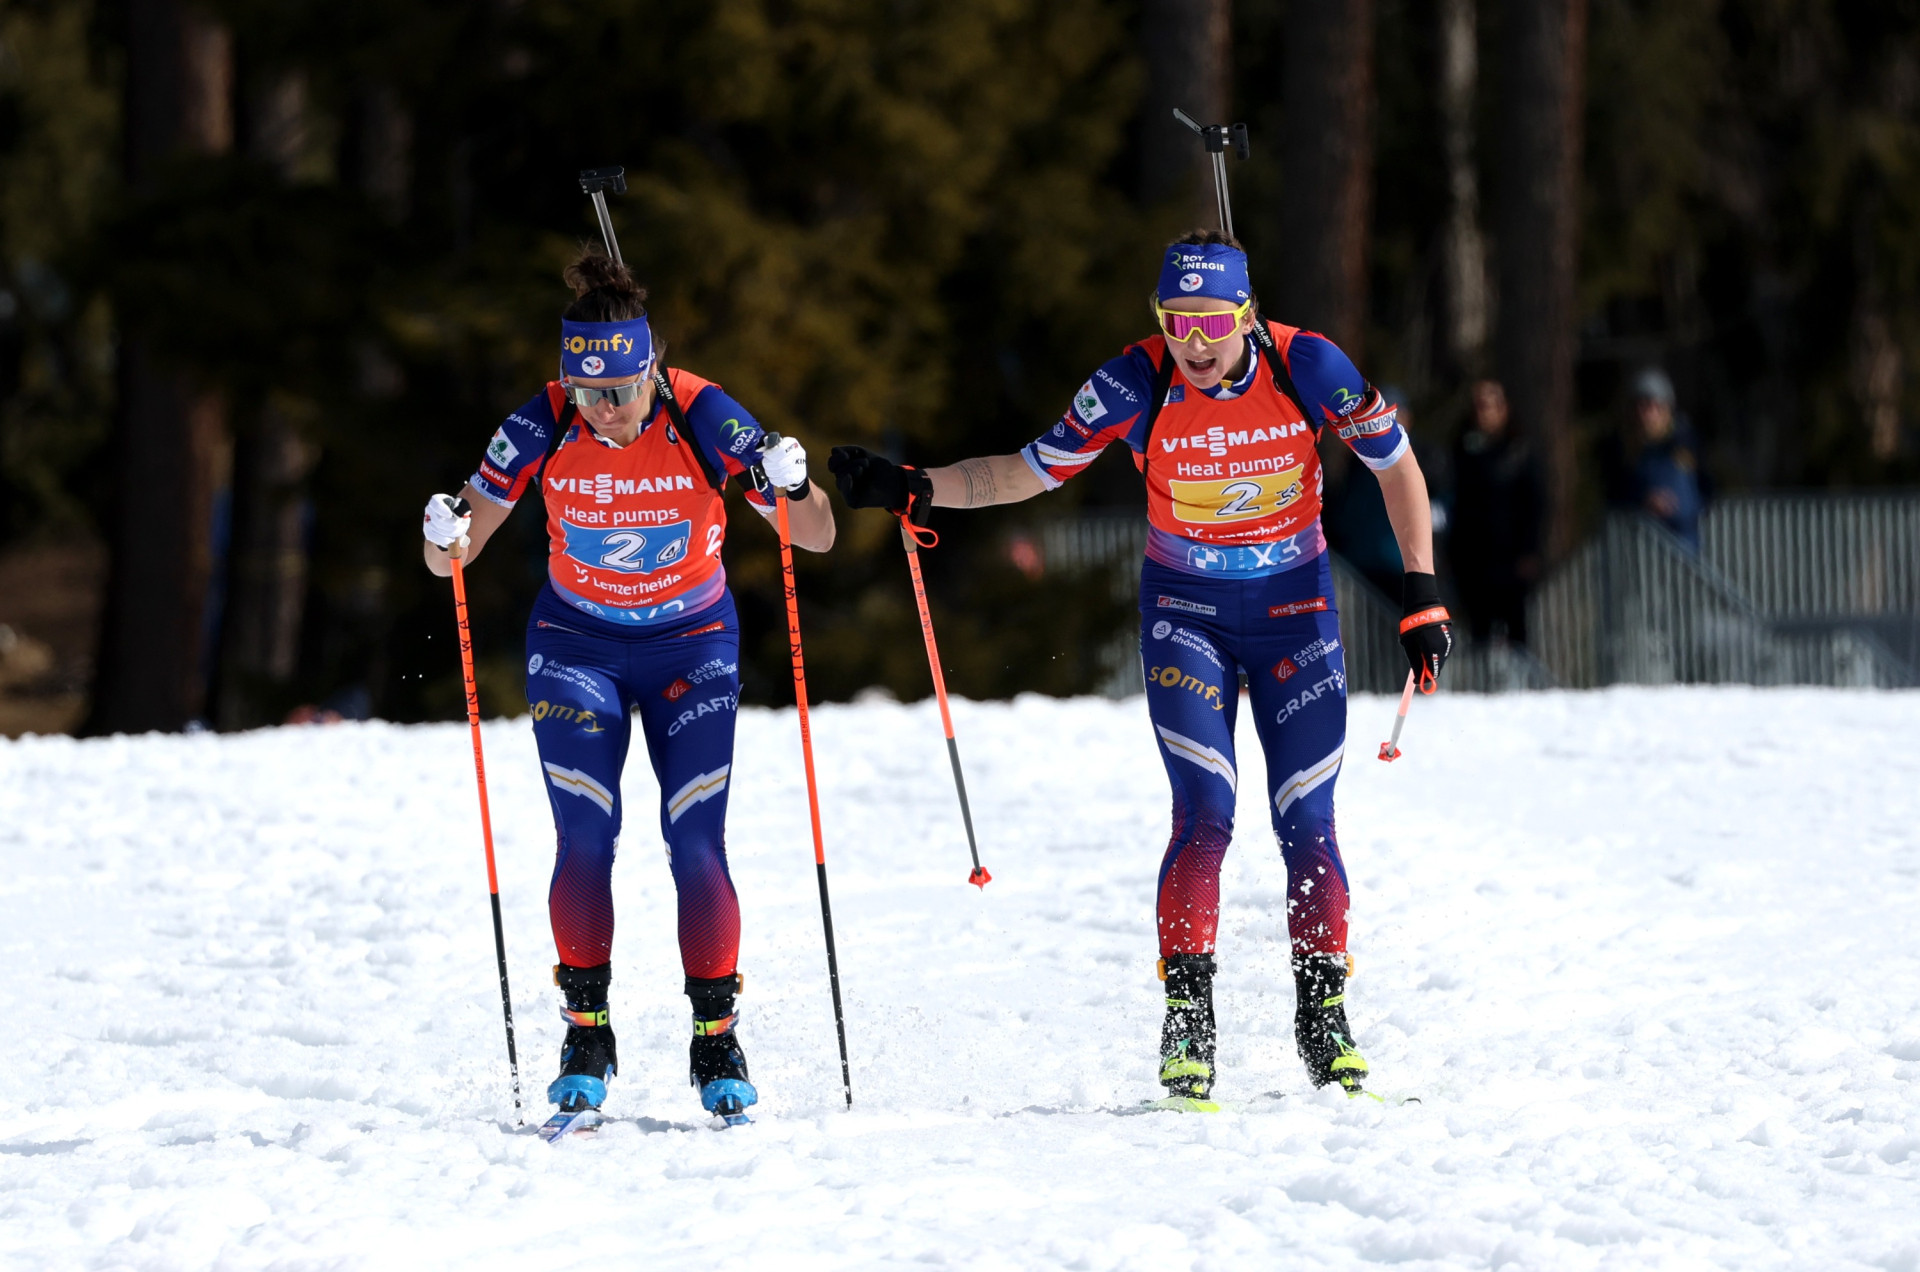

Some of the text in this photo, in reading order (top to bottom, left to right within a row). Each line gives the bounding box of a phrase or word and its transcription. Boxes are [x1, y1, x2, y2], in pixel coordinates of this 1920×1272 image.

[1182, 254, 1205, 263] ROY
[563, 333, 634, 355] somfy
[1096, 368, 1129, 395] CRAFT
[1337, 399, 1355, 416] ROY
[506, 413, 538, 432] RAFT
[729, 430, 749, 454] ROY
[1161, 421, 1308, 457] VIESSMANN
[1176, 452, 1296, 478] Heat pumps
[548, 473, 695, 504] VIESSMANN
[1214, 481, 1264, 518] 2
[564, 504, 680, 526] Heat pumps
[599, 530, 686, 570] 2 4
[705, 524, 722, 556] 2
[593, 574, 682, 597] Lenzerheide
[1271, 600, 1324, 615] VIESSMANN
[1293, 637, 1327, 661] CAISSE
[687, 658, 725, 680] CAISSE
[1149, 665, 1225, 711] somfy
[1276, 675, 1335, 725] CRAFT
[529, 700, 606, 734] somfy
[667, 697, 731, 738] CRAFT
